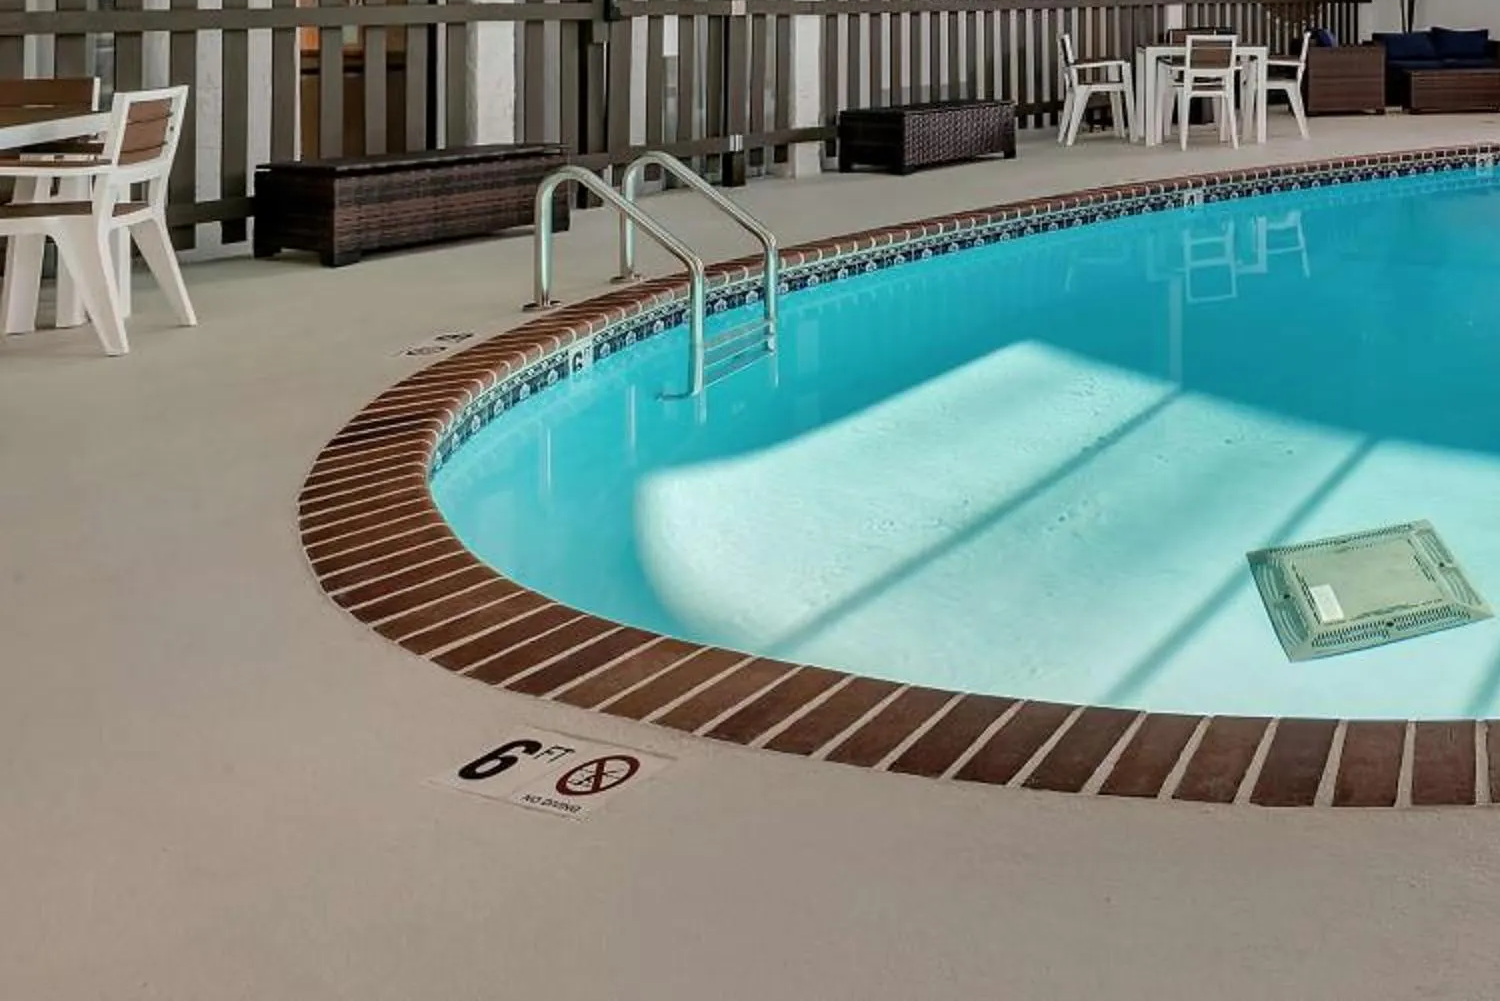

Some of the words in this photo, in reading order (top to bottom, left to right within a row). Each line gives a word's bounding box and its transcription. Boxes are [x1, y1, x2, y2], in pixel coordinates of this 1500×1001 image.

[459, 740, 542, 780] 6
[534, 745, 576, 763] FT
[521, 794, 542, 803] NO
